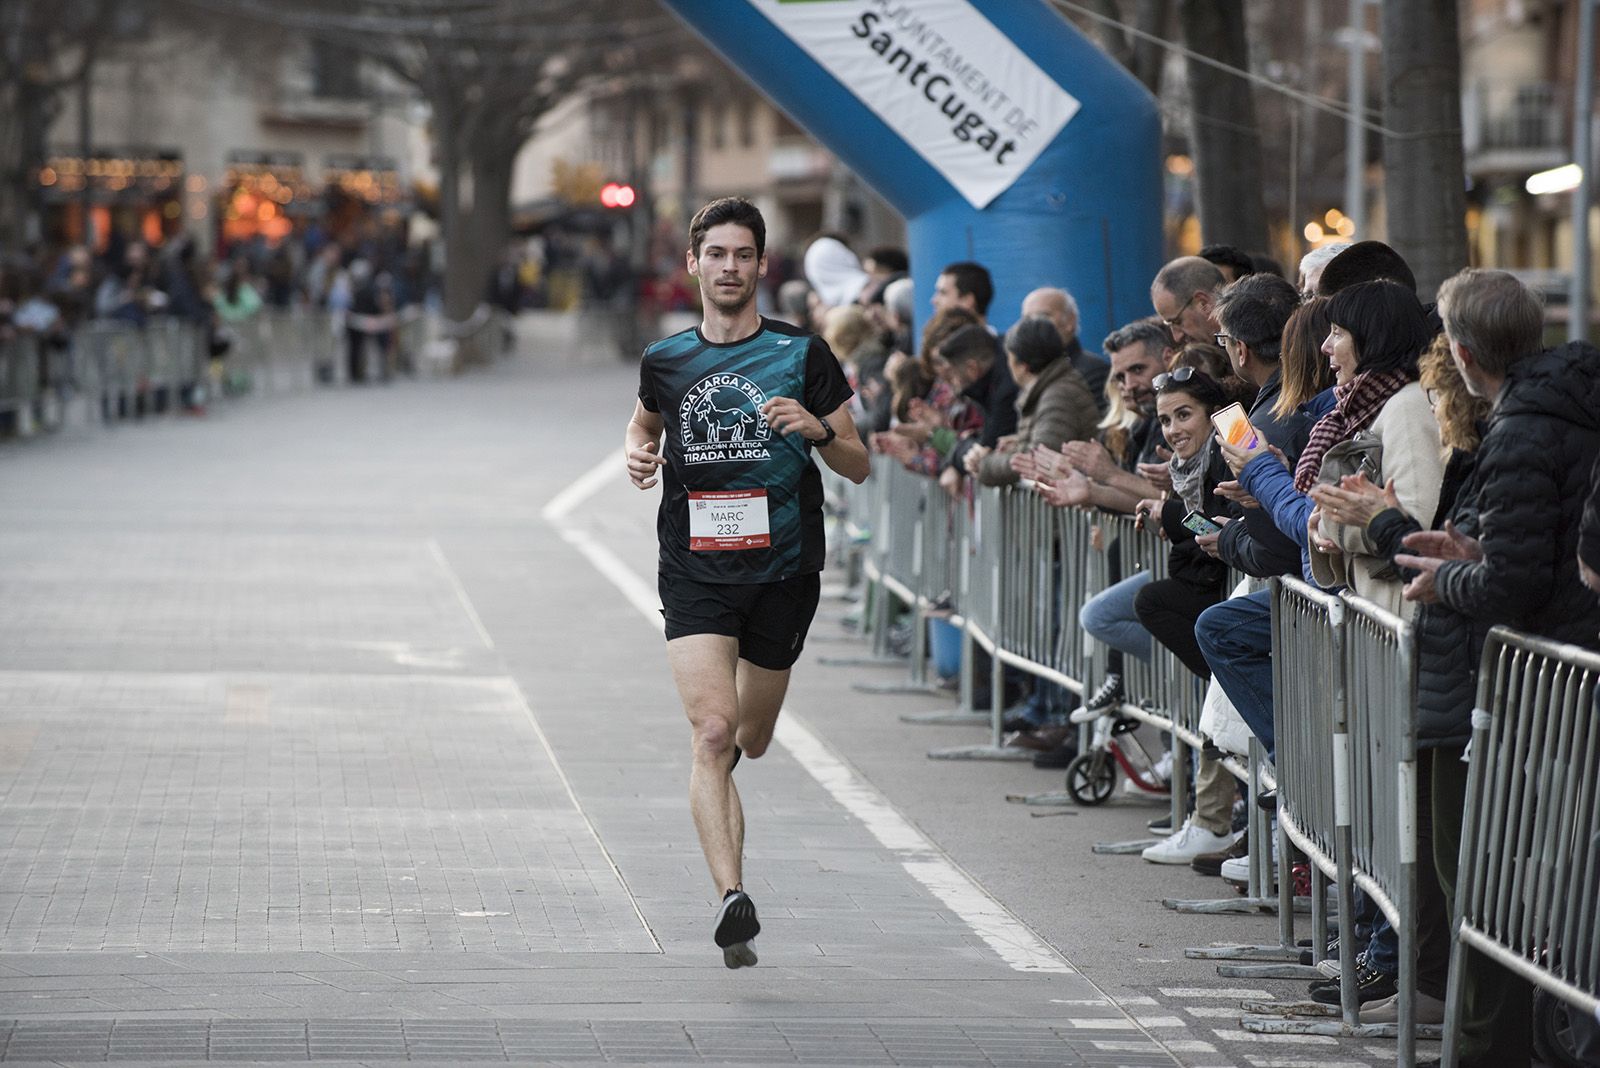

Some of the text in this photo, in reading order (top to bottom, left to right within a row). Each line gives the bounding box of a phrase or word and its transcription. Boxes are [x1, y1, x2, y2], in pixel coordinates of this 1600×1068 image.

[851, 11, 1019, 165] SantCugat
[1003, 105, 1039, 139] DE
[681, 394, 698, 442] TIRADA
[696, 375, 739, 394] LARGA
[687, 441, 763, 452] ASOCIACIÓN ATLÉTICA
[684, 449, 771, 463] TIRADA LARGA
[711, 512, 744, 522] MARC
[717, 524, 740, 535] 232
